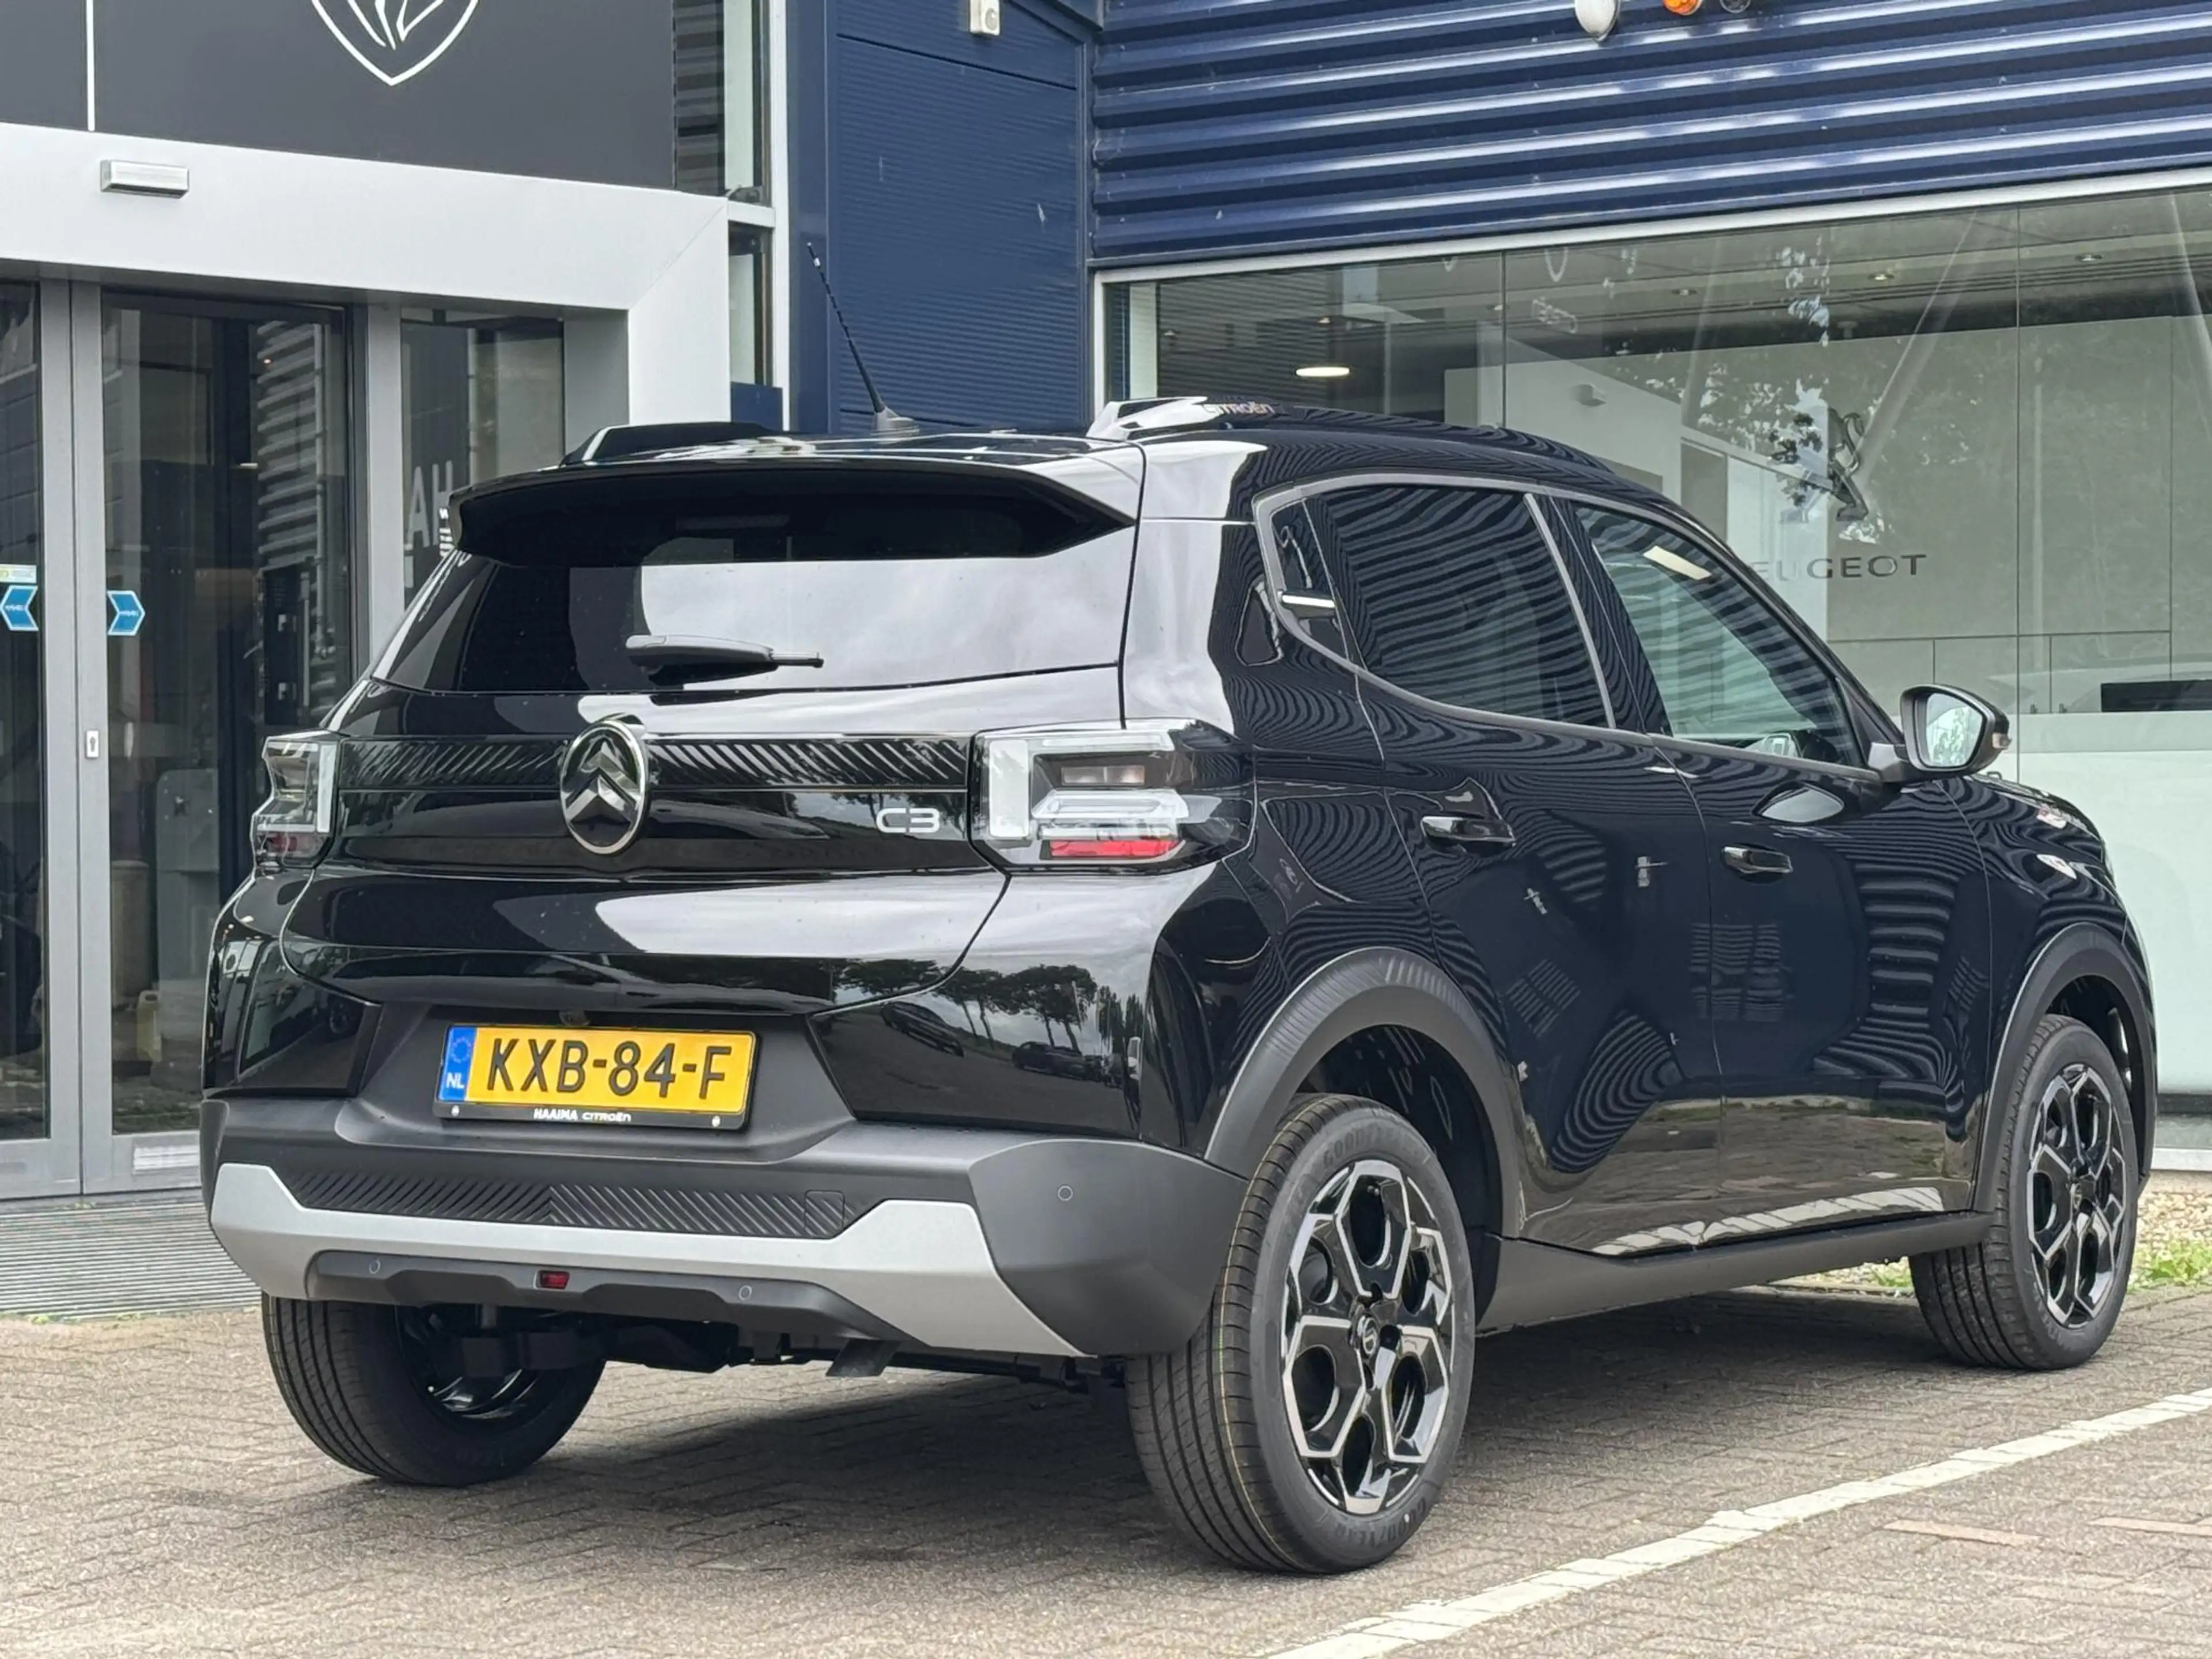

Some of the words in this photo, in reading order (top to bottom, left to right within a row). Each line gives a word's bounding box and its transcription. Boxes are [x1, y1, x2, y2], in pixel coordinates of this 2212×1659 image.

[1749, 554, 1927, 581] EUGEOT
[876, 808, 940, 834] C3
[445, 1072, 465, 1089] NL
[486, 1038, 733, 1099] KXB-84-F
